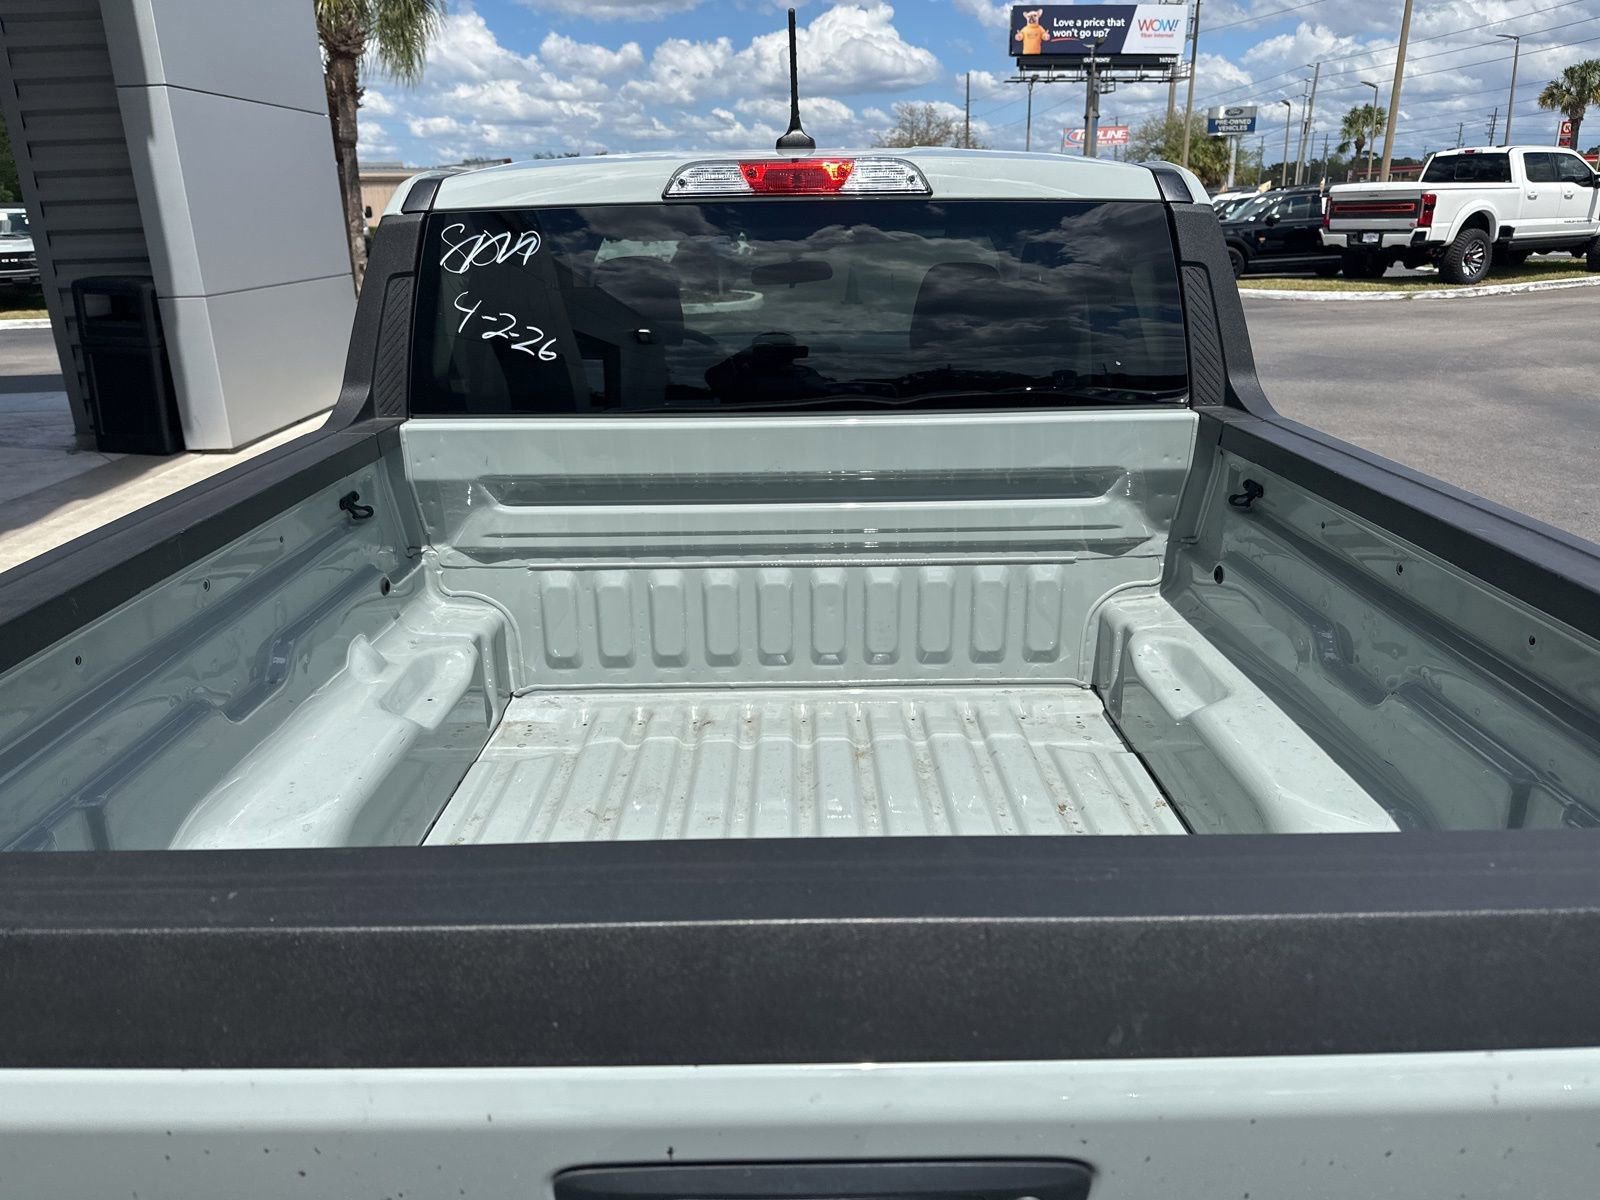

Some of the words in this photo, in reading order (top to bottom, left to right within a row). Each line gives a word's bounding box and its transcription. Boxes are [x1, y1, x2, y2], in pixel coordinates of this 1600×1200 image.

[1053, 17, 1074, 27] Love
[1075, 19, 1082, 27] a
[1083, 17, 1105, 28] price
[1107, 17, 1125, 27] that
[1138, 19, 1180, 32] WOW!
[1053, 28, 1078, 38] won't
[1079, 29, 1091, 39] go
[1092, 28, 1110, 38] up?
[1073, 128, 1128, 141] TLINE
[454, 291, 557, 361] 4-2-26
